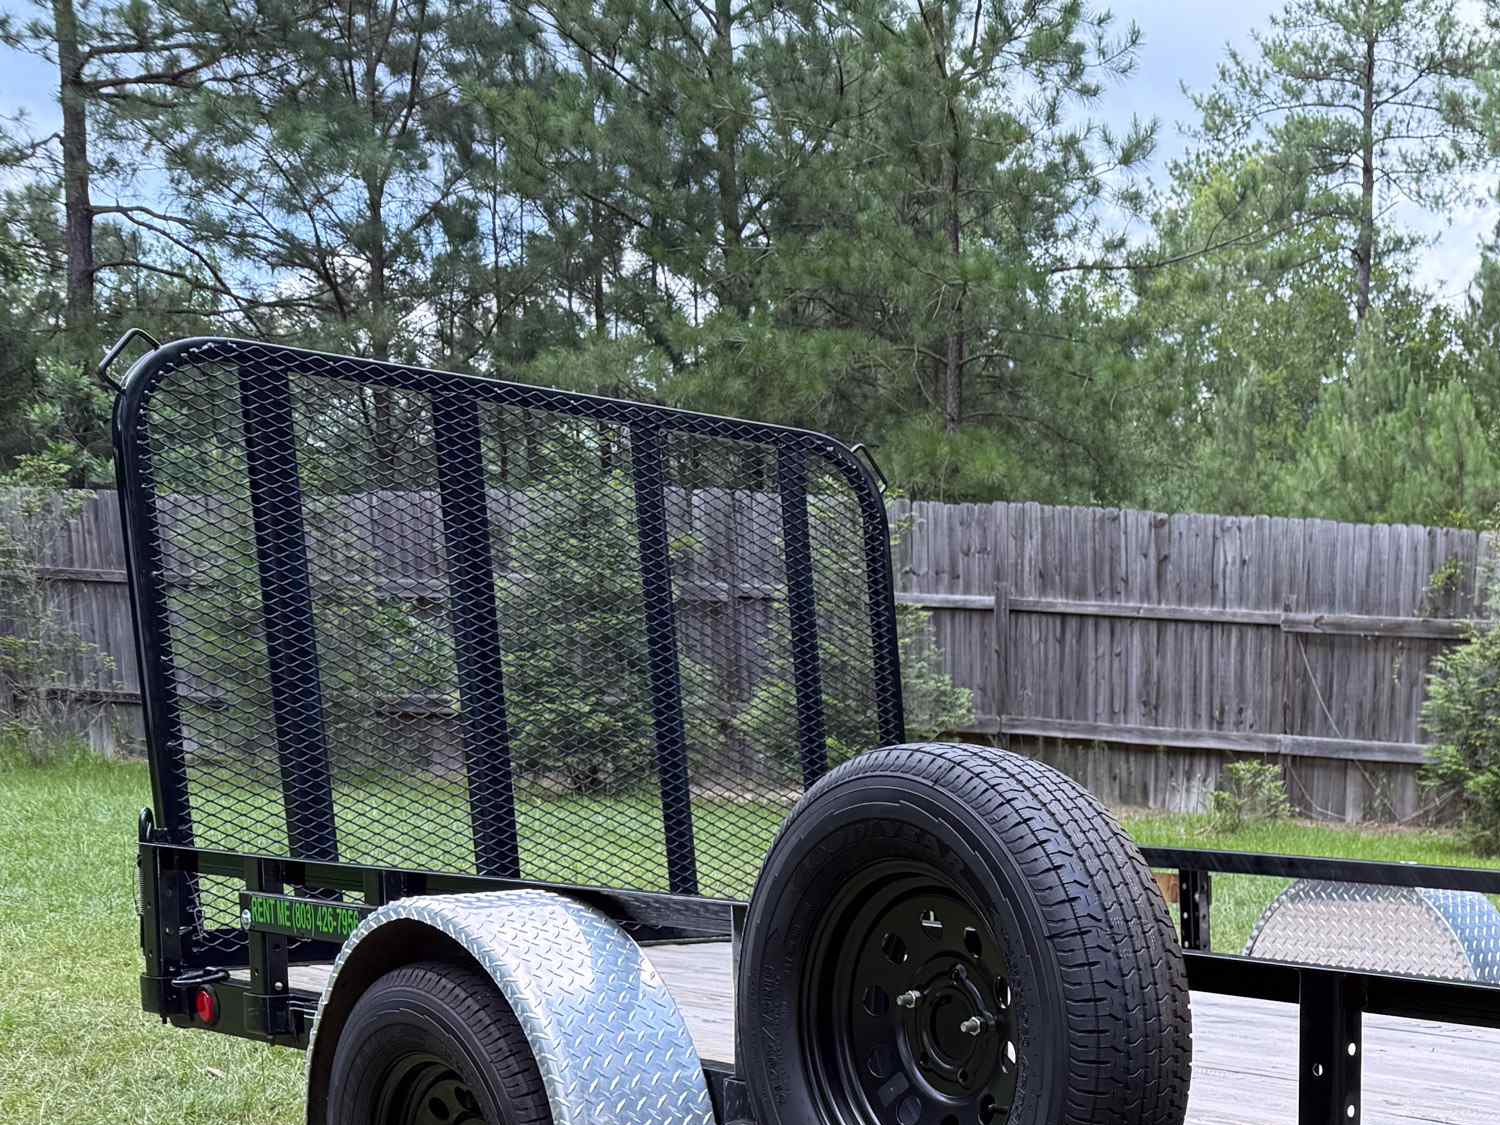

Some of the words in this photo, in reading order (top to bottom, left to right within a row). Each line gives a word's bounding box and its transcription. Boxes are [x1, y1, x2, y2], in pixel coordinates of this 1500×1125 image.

[251, 896, 275, 924] RENT
[276, 900, 291, 927] ME
[292, 902, 315, 937] (803)
